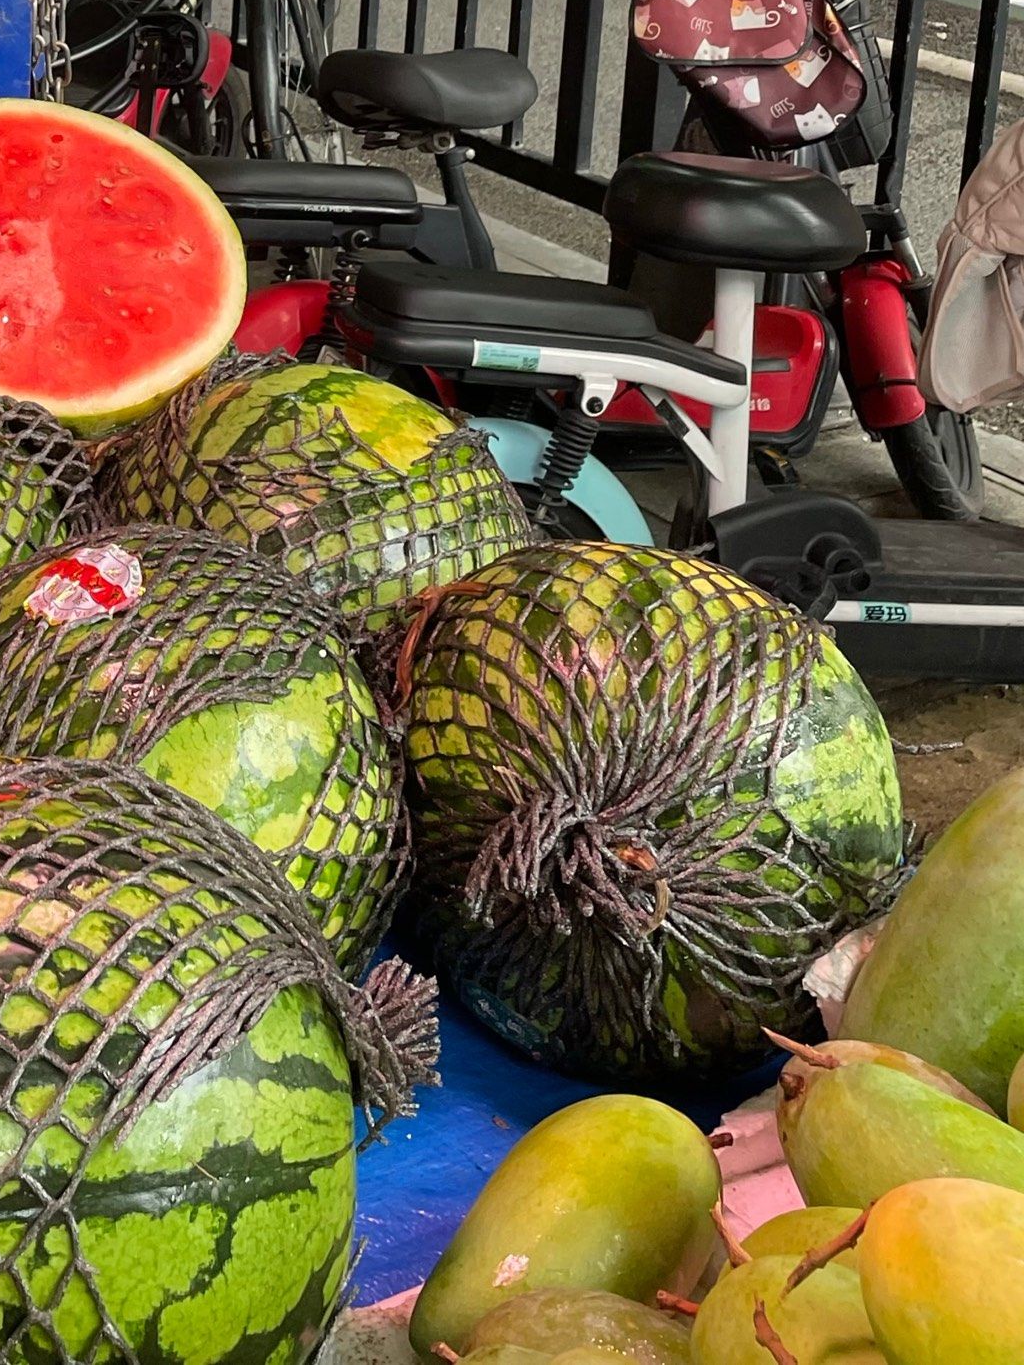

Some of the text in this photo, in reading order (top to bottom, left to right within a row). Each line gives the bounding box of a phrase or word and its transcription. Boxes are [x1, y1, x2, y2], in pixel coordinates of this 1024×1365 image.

[690, 16, 714, 35] CATS
[770, 97, 796, 119] CATS
[864, 605, 907, 622] 爱玛
